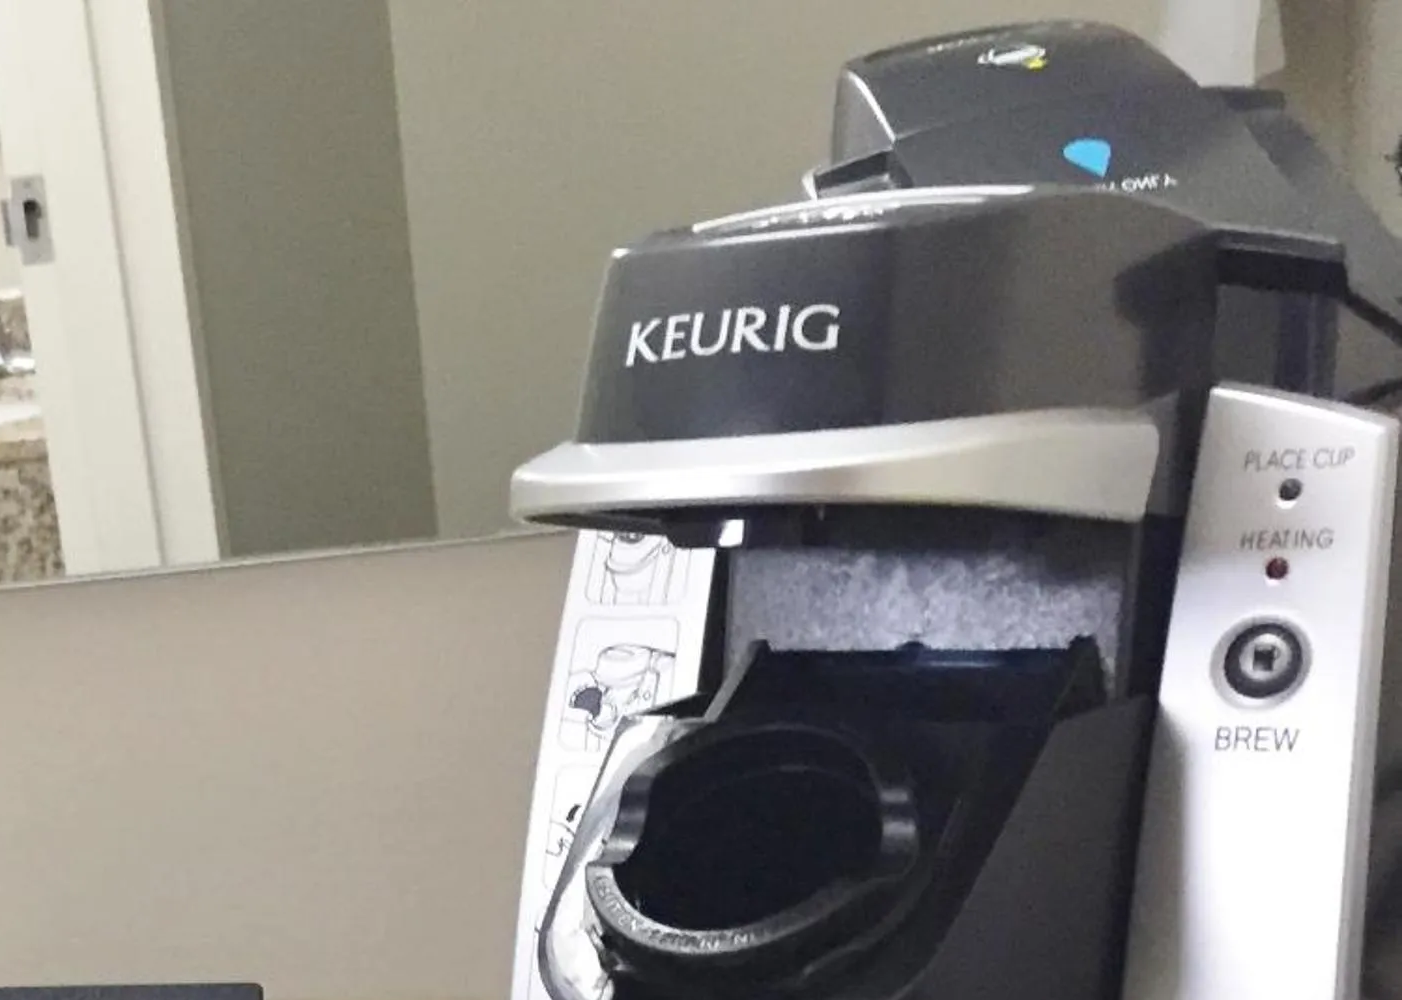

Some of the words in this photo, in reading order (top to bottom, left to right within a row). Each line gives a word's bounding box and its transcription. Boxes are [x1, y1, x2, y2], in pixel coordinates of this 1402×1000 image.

[625, 304, 841, 366] KEURIG
[1244, 448, 1307, 472] PLACE
[1313, 446, 1356, 470] CUP
[1239, 528, 1336, 550] HEATING
[1214, 726, 1301, 752] BREW
